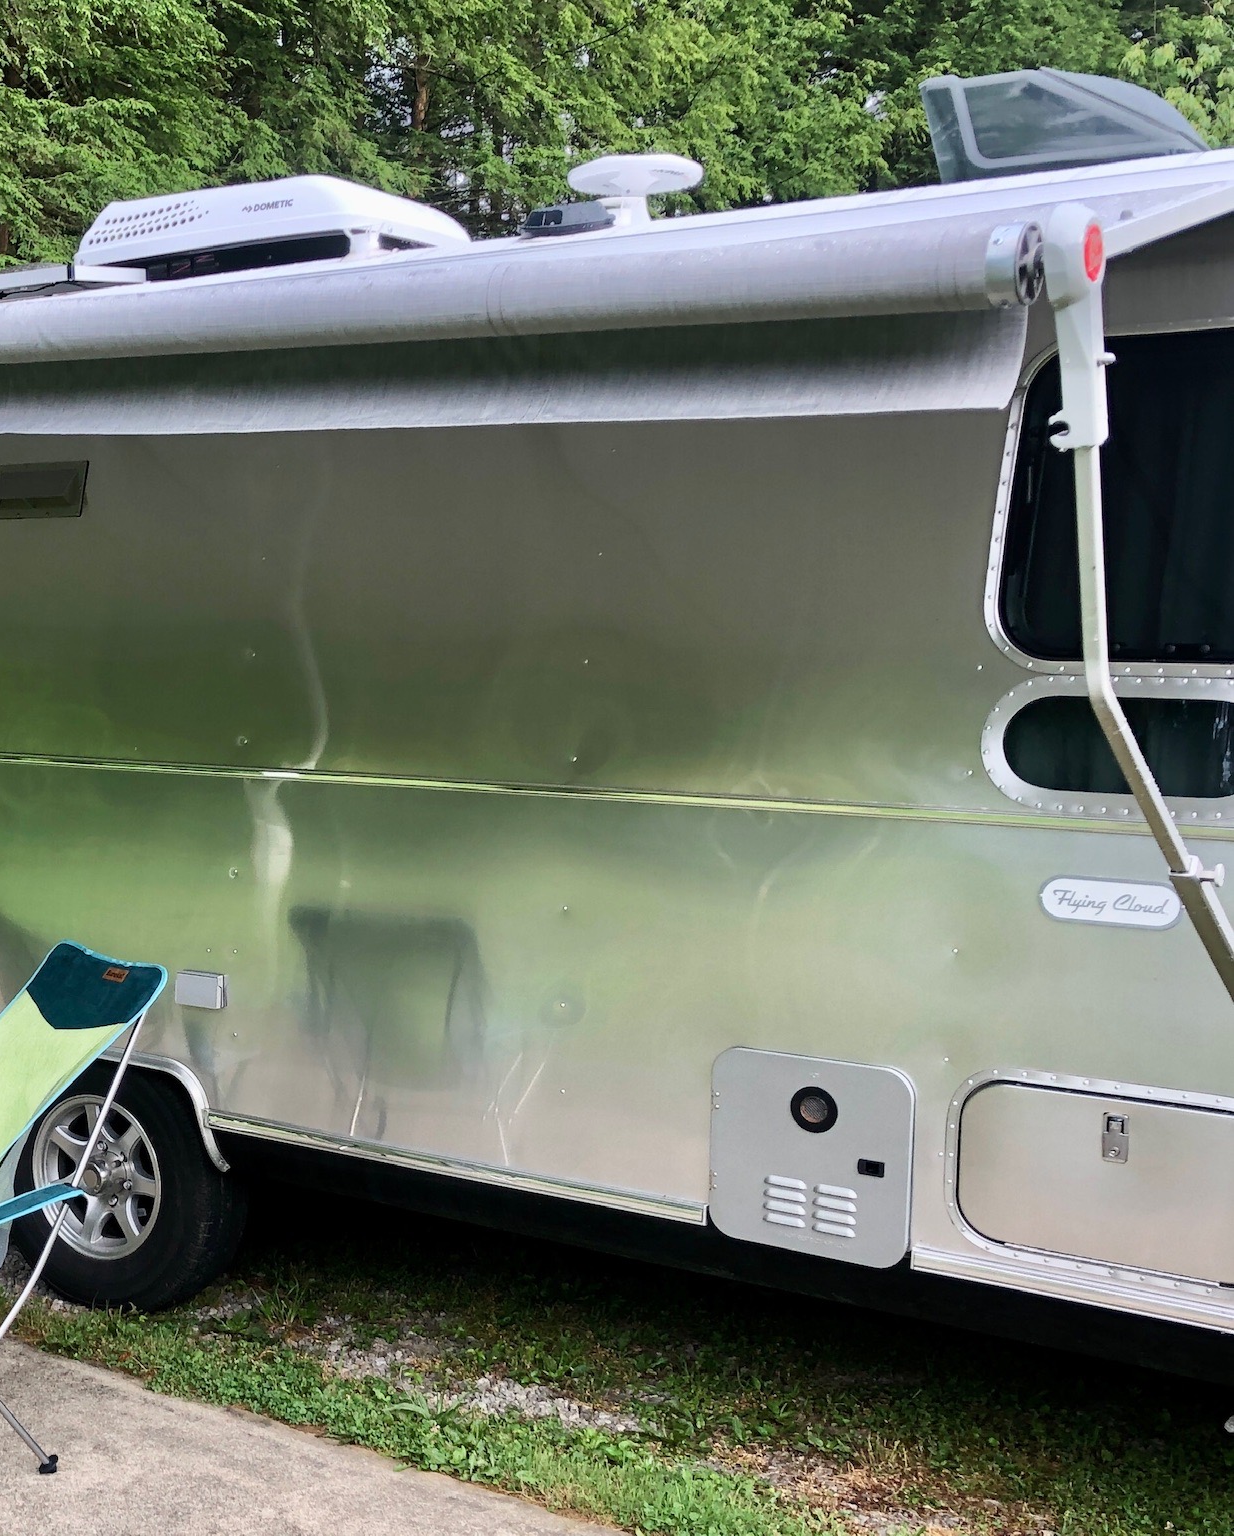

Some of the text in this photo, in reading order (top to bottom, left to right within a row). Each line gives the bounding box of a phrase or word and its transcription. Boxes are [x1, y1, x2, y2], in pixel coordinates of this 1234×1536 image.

[253, 198, 294, 212] DOMETIC
[1053, 889, 1169, 916] Flying Cloud
